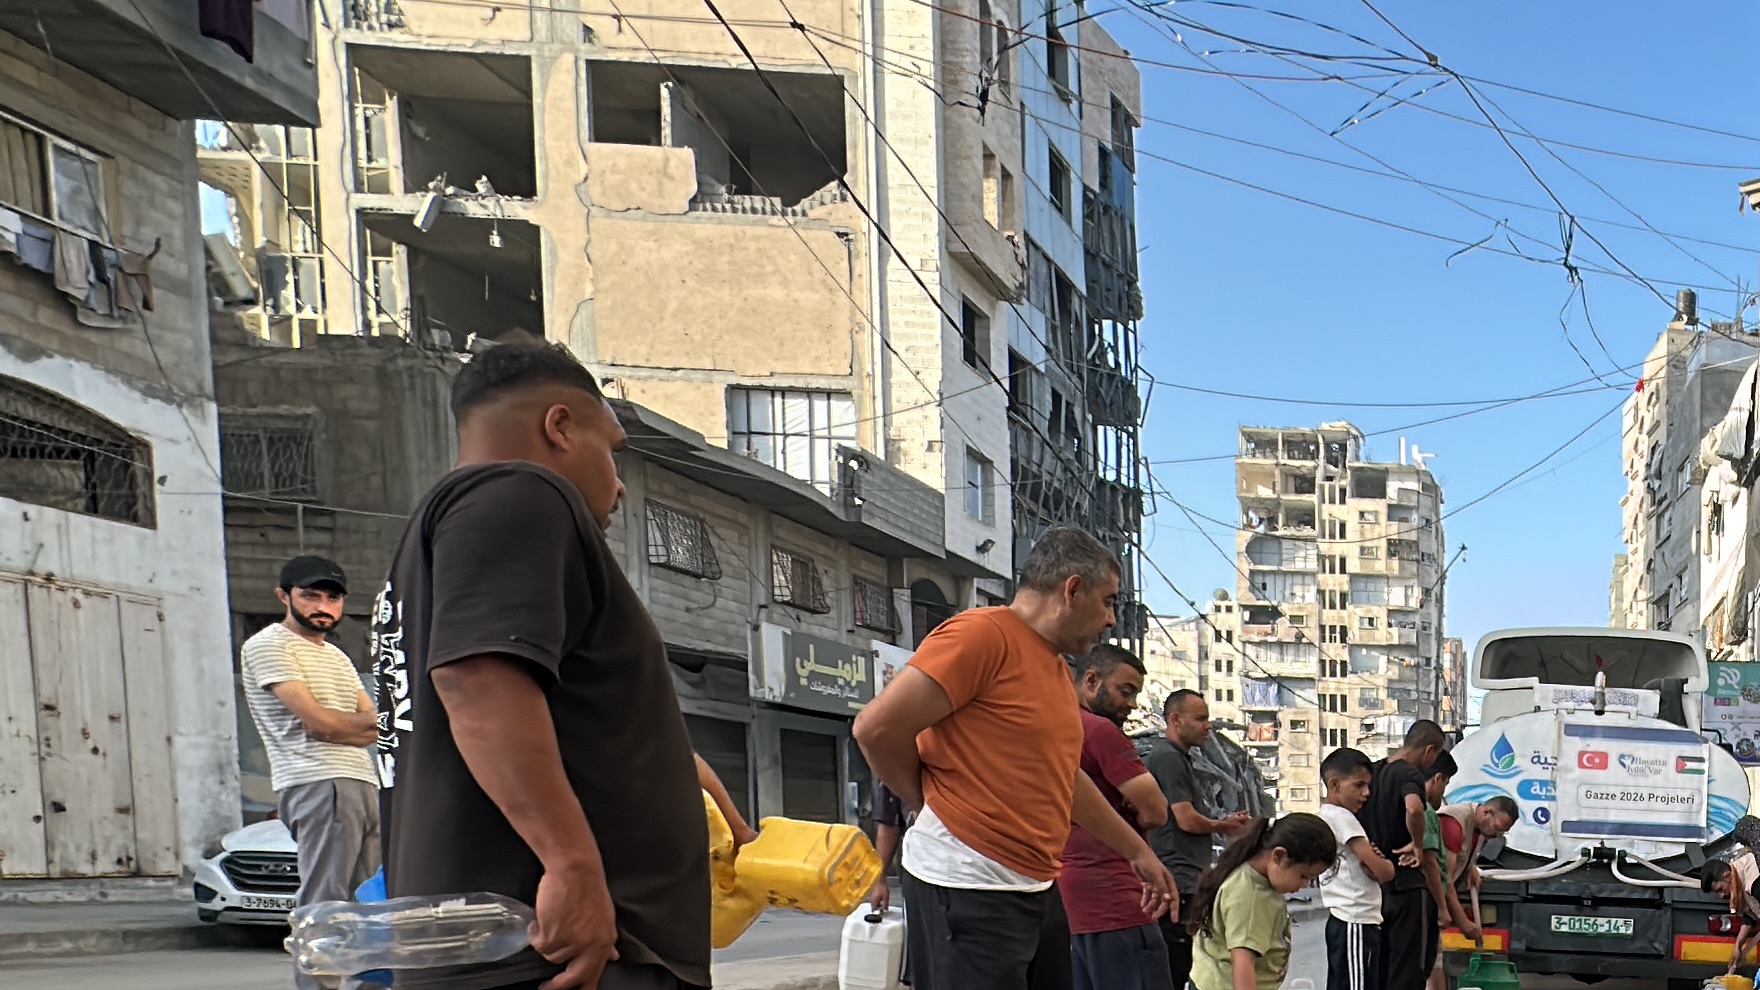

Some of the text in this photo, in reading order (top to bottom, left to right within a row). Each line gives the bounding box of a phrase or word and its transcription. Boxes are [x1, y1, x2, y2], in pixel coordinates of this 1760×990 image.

[1585, 790, 1695, 805] Gazze 2026 Projeleri
